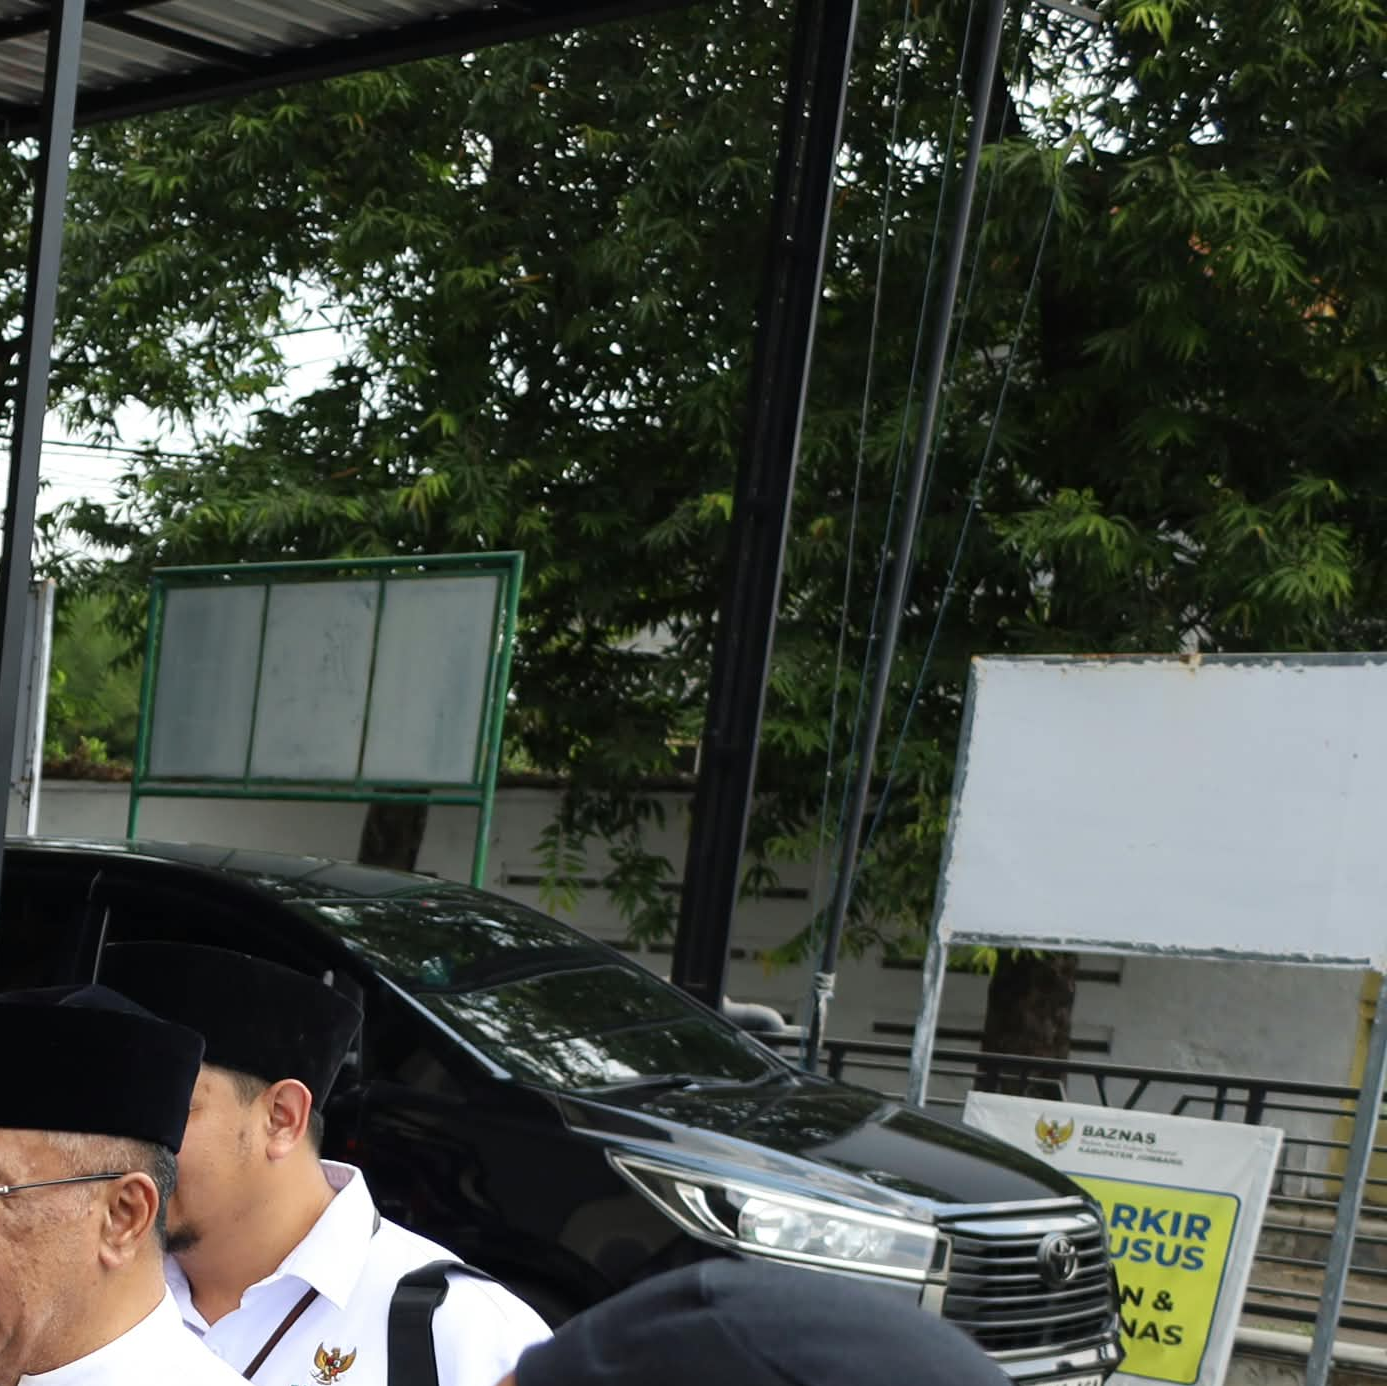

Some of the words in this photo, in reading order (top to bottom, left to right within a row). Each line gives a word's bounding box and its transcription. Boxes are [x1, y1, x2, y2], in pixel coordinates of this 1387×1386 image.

[1082, 1125, 1157, 1145] BAZNAS
[1110, 1202, 1212, 1241] RKIR
[1109, 1234, 1206, 1271] USUS
[1119, 1315, 1183, 1346] NAS
